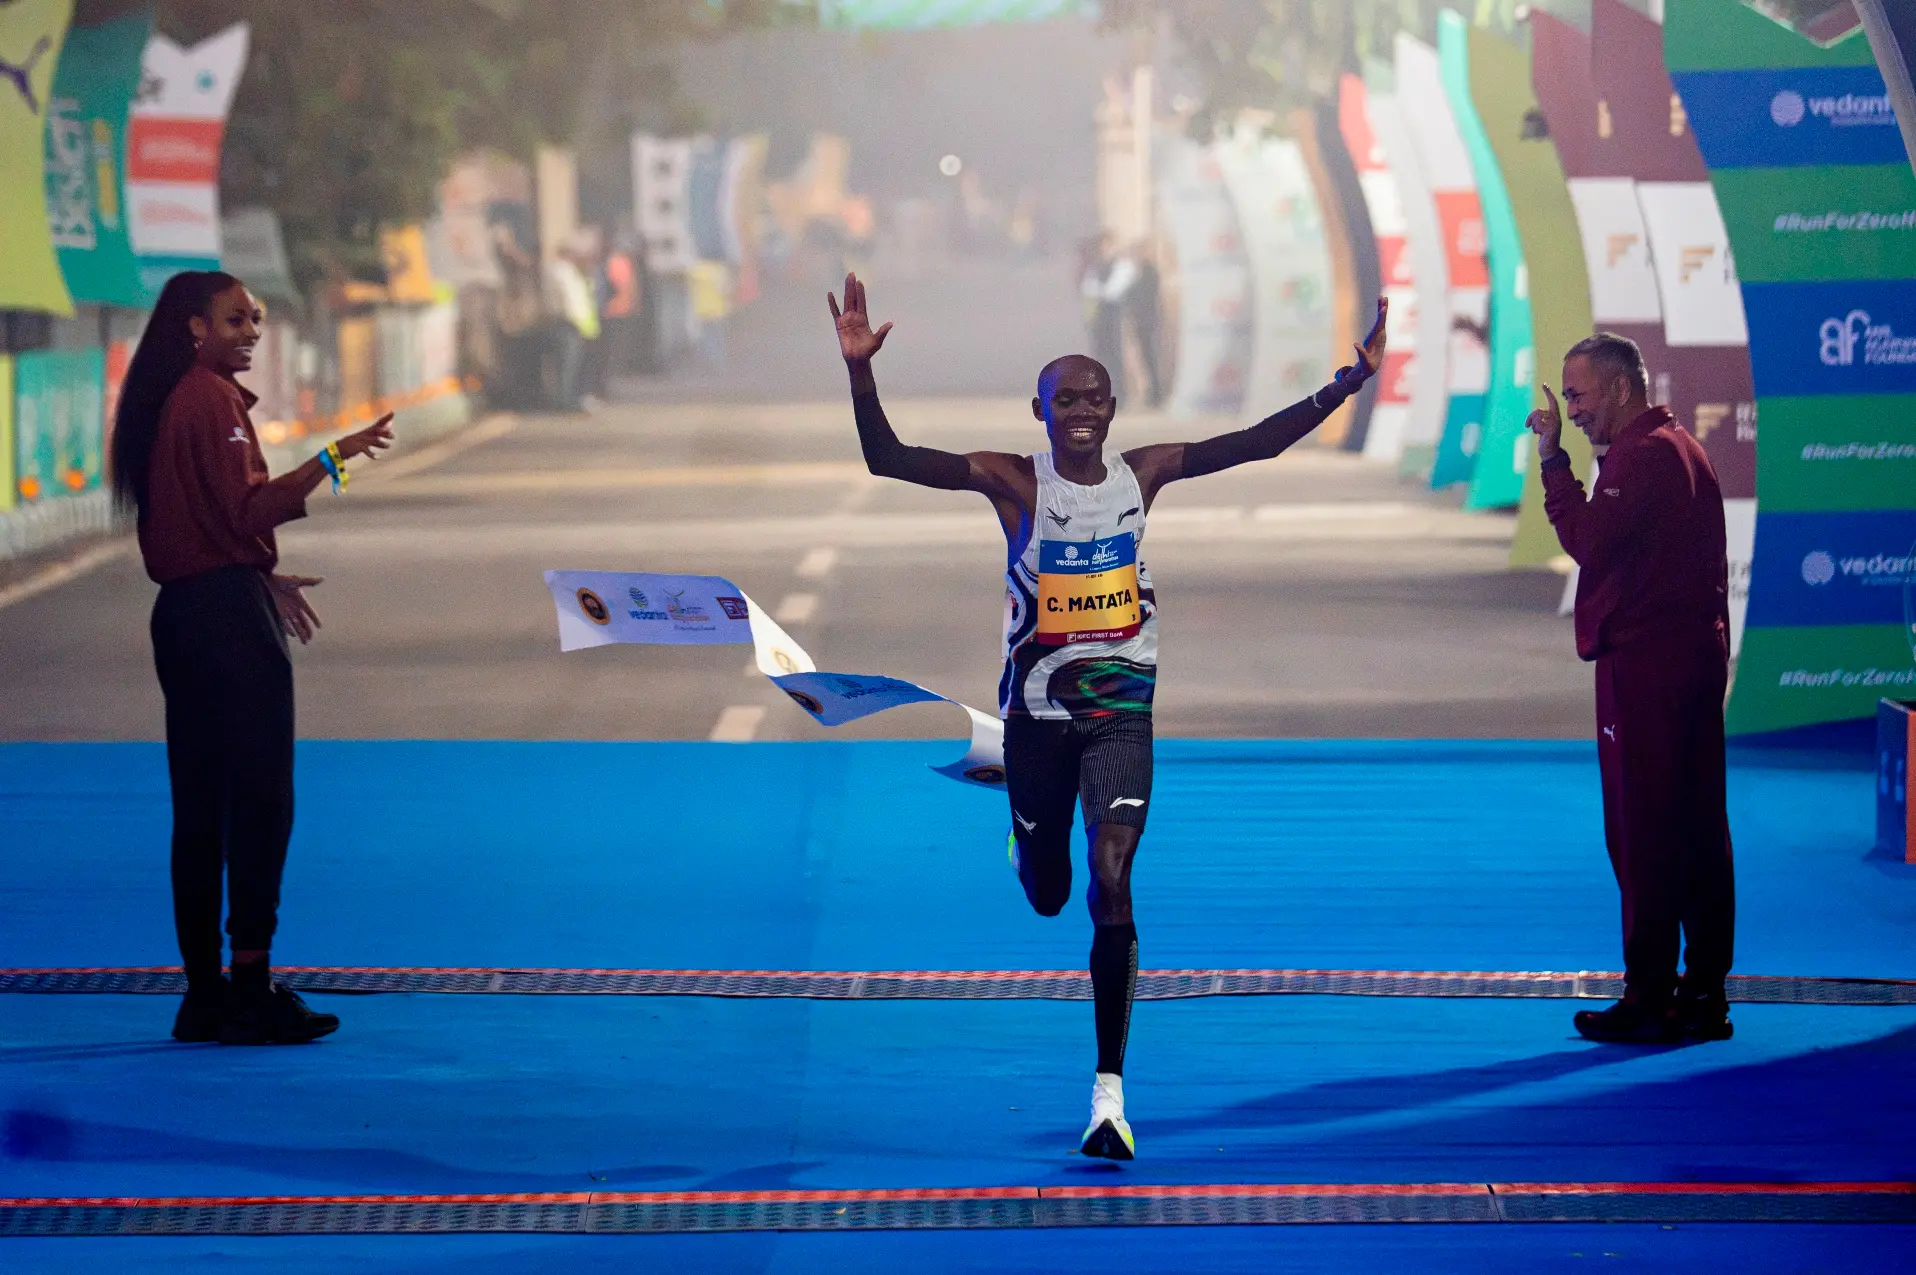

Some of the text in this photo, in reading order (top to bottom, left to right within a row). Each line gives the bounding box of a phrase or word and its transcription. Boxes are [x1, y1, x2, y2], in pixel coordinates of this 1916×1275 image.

[1055, 558, 1089, 566] vedanta
[1046, 588, 1133, 613] C. MATATA
